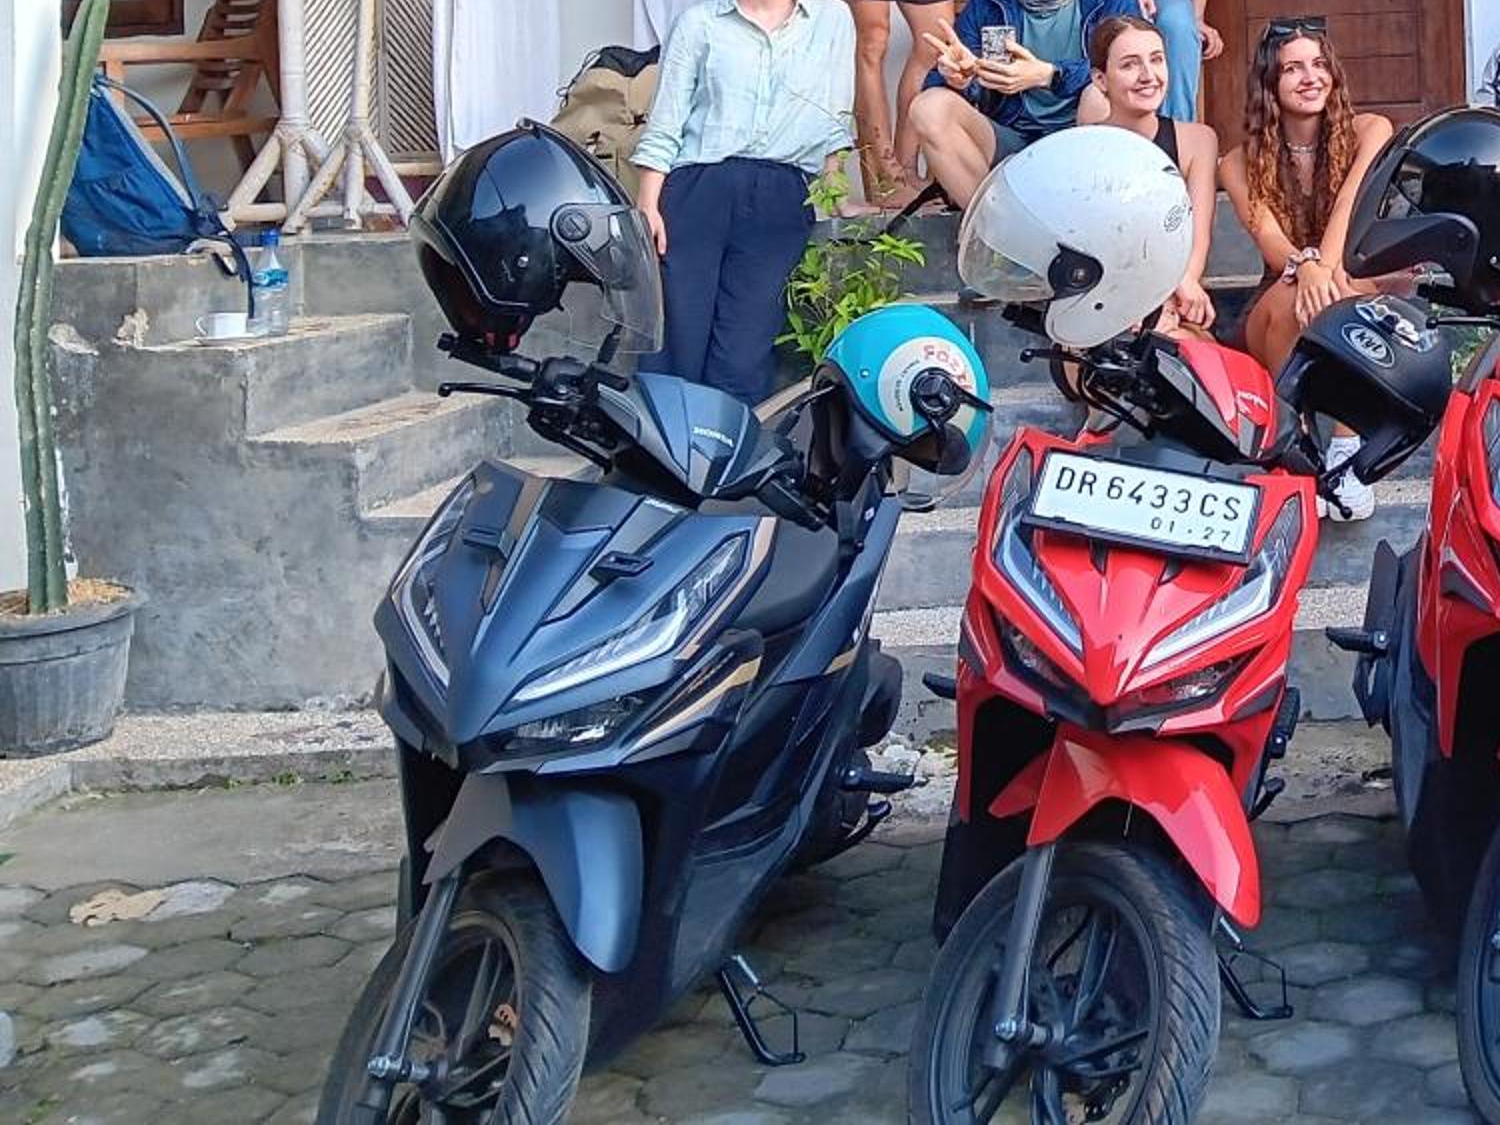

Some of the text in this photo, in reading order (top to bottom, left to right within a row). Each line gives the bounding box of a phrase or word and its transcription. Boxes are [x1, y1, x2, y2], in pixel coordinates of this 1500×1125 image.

[1054, 465, 1242, 522] DR 6433 CS
